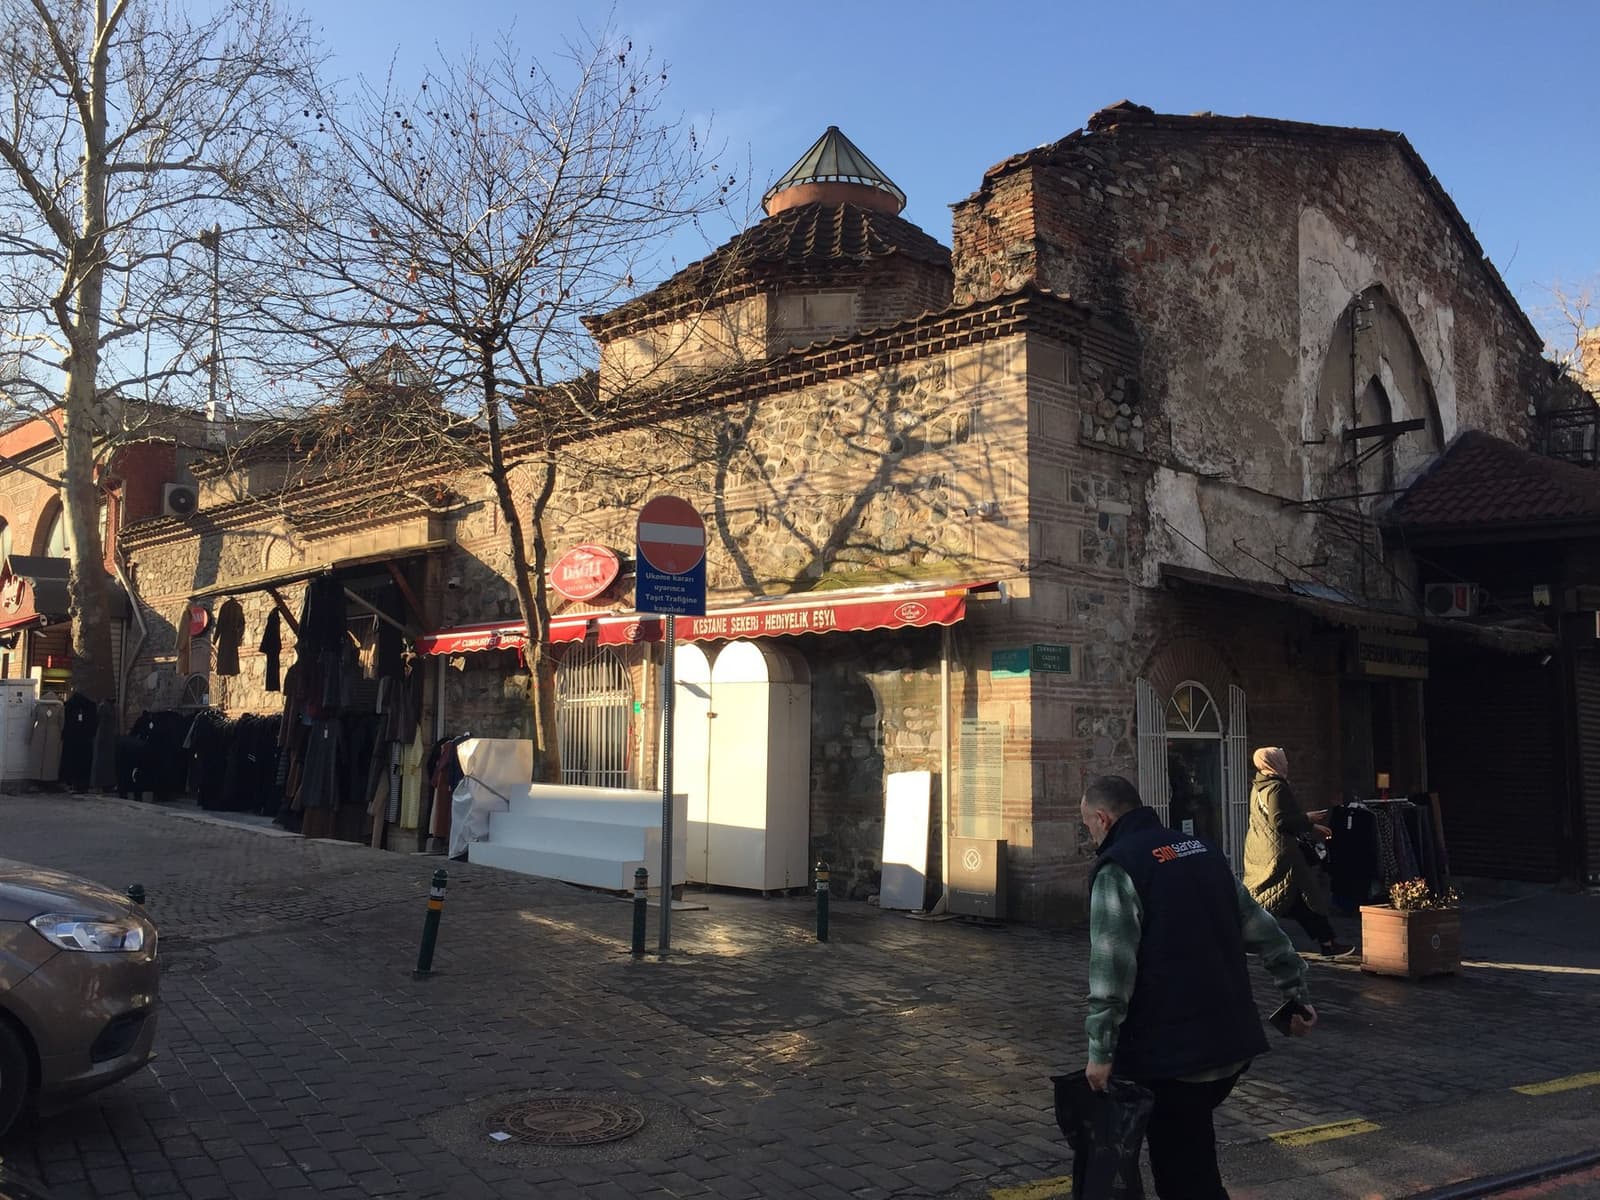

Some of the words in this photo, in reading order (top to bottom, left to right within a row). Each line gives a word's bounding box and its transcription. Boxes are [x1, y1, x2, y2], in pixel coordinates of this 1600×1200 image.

[693, 616, 727, 635] KESTANE
[731, 615, 759, 634] ŞEKERİ
[764, 611, 809, 631] HEDİYELİK
[813, 609, 836, 628] EŞYA
